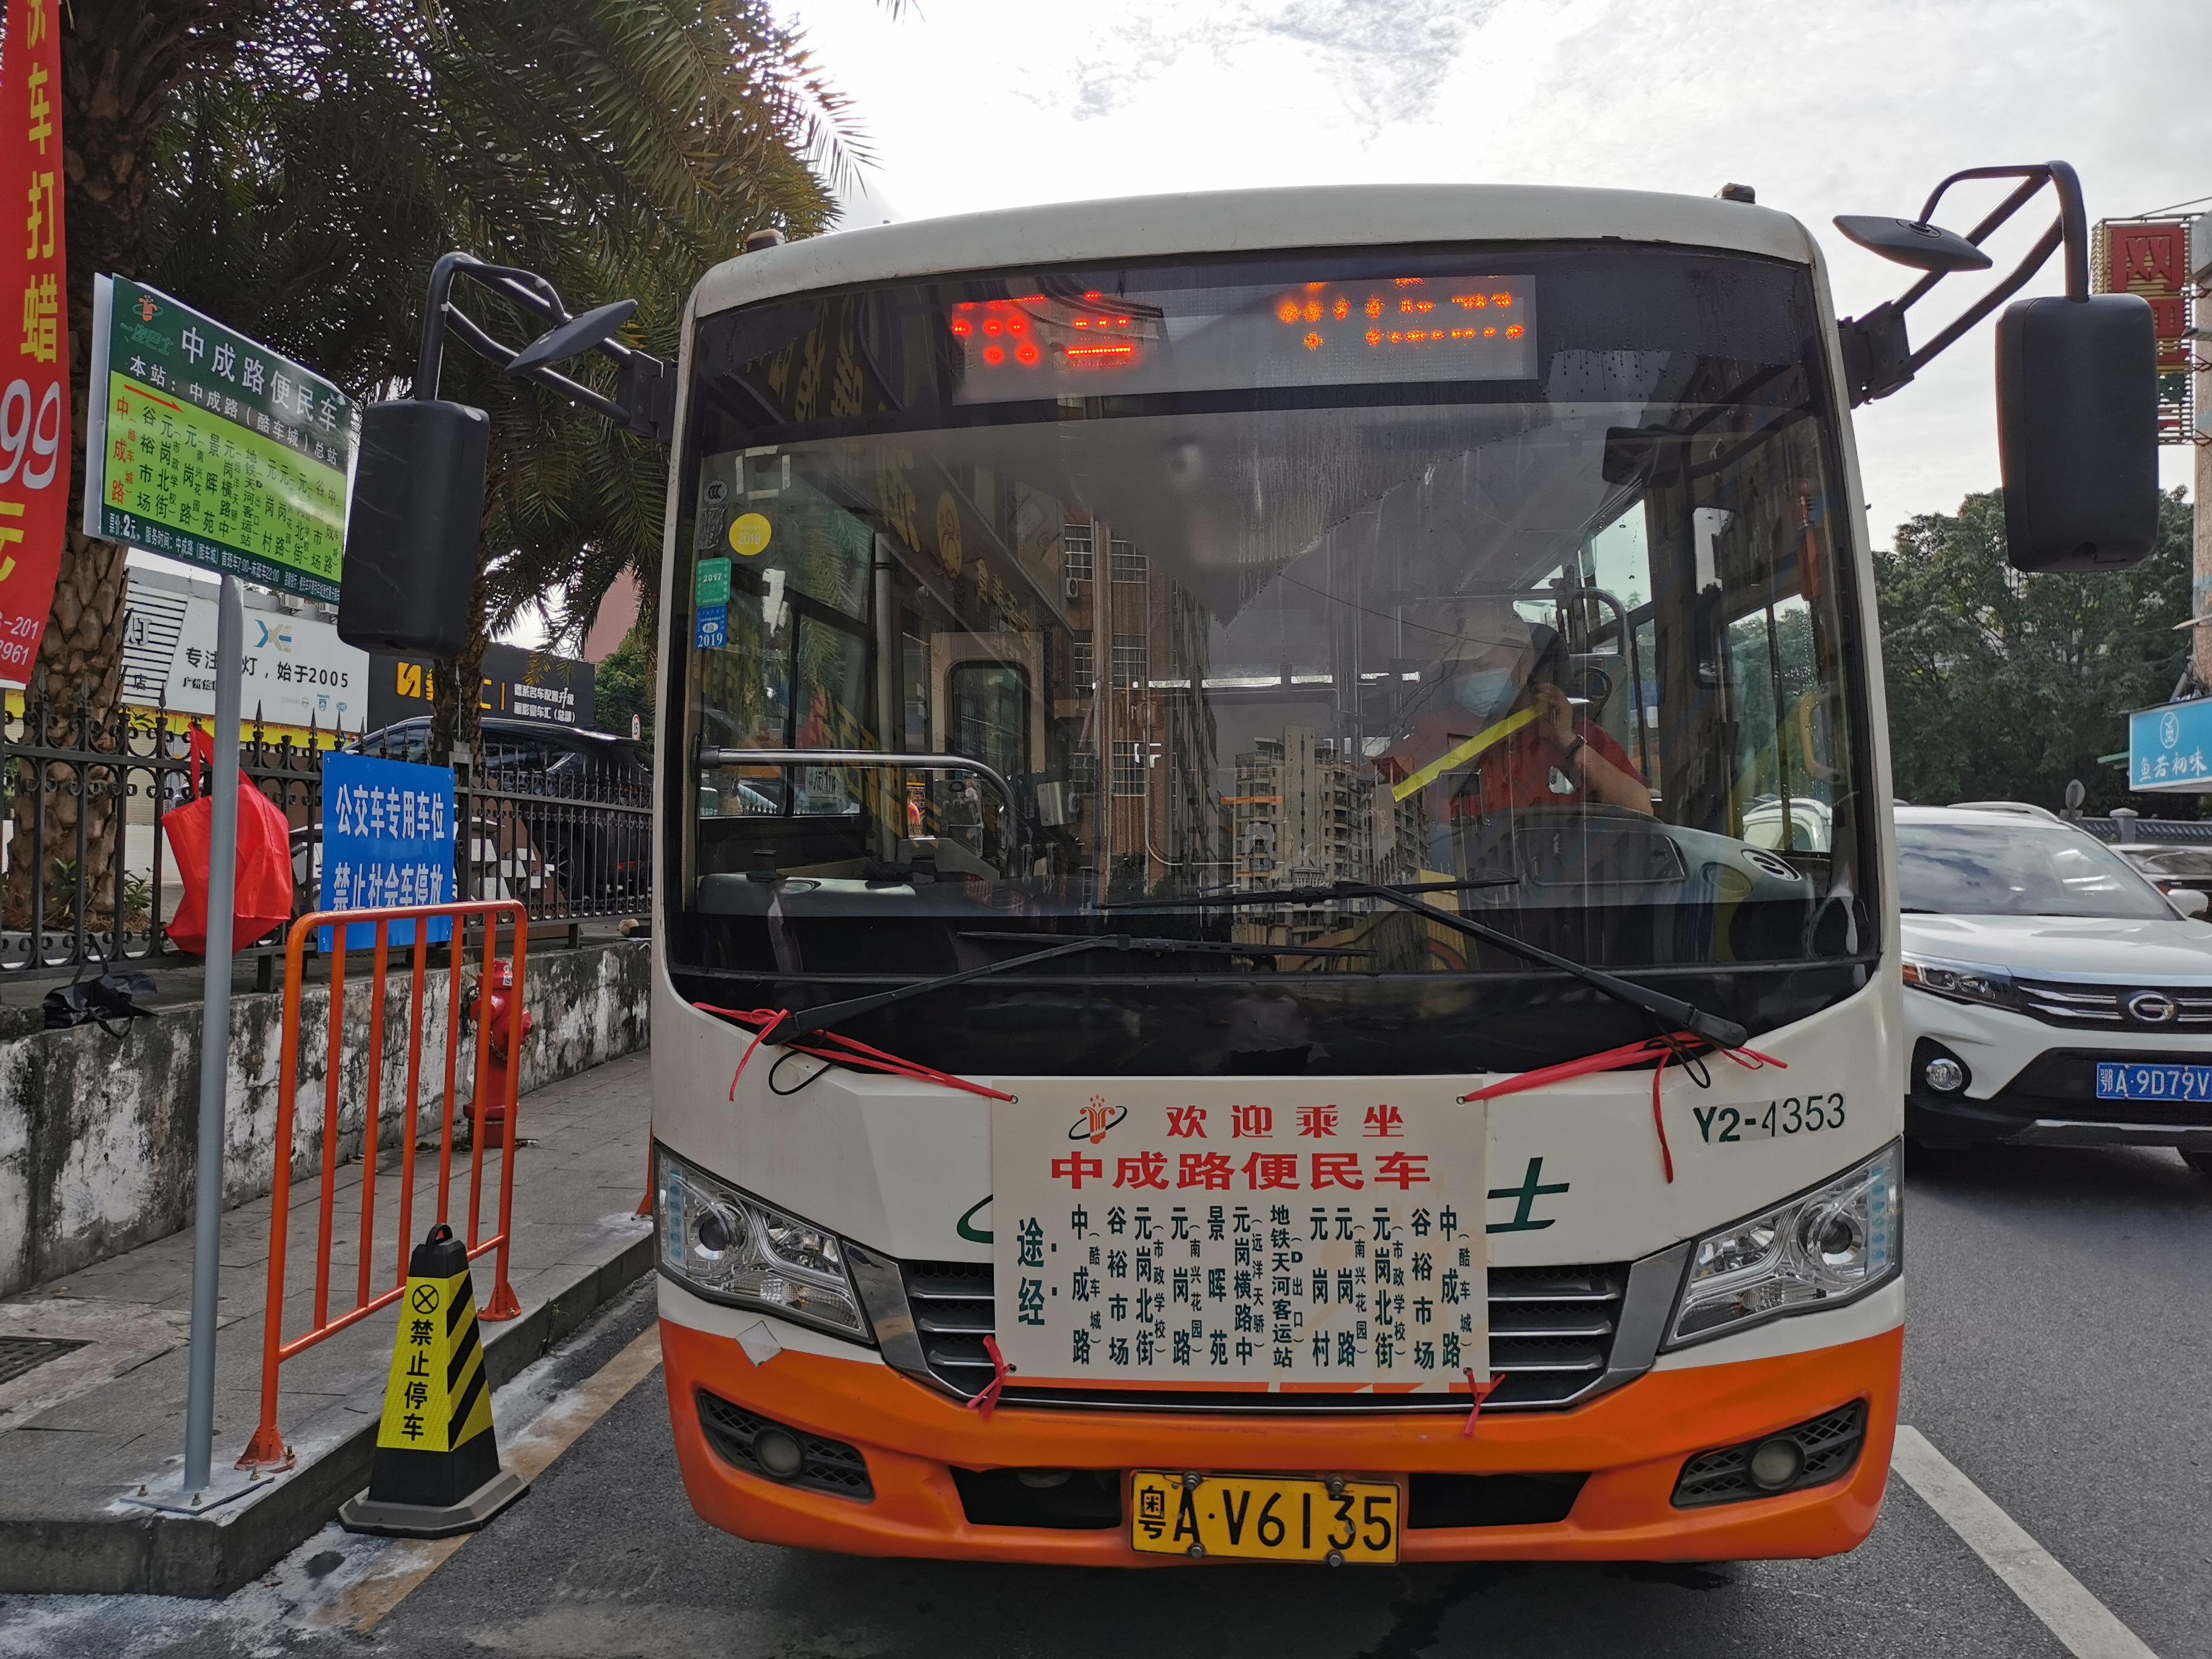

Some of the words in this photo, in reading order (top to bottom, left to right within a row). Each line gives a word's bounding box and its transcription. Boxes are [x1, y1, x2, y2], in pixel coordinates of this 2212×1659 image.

[182, 326, 338, 432] 中成路便民车
[112, 395, 129, 504] 中成路
[136, 406, 157, 512] 谷裕市场
[155, 414, 173, 519] 元岗北街
[179, 424, 197, 526] 元岗路
[218, 439, 235, 538] 元岗横路中
[240, 448, 258, 548] 地铁天河客运站
[262, 458, 277, 553] 元岗村
[274, 464, 290, 558] 元岗路
[0, 611, 39, 640] -201
[697, 632, 723, 648] 2019
[335, 783, 445, 842] 公交车专用车位
[333, 861, 444, 911] 禁止社会车停放
[1050, 1150, 1431, 1191] 中成路便民车
[1165, 1104, 1406, 1140] 欢迎乘坐
[1692, 1092, 1846, 1143] Y2-4353
[1071, 1203, 1091, 1366] 中成路
[1088, 1232, 1102, 1344] （酷车城）
[1107, 1205, 1129, 1366] 谷裕市场
[1134, 1206, 1155, 1366] 元岗北街
[1152, 1224, 1167, 1353] （市政学校）
[1170, 1207, 1191, 1366] 元岗路
[1188, 1224, 1203, 1353] （南兴花园）
[1207, 1205, 1228, 1366] 景晖苑
[1232, 1206, 1253, 1366] 元岗横路中
[1250, 1218, 1265, 1349] （远洋天骄）
[1270, 1204, 1293, 1369] 地铁天河客运站
[1290, 1237, 1305, 1344] （D出口）
[1310, 1207, 1330, 1368] 元岗村
[1335, 1207, 1356, 1368] 元岗路
[1353, 1225, 1368, 1355] （南兴花园）
[1372, 1207, 1394, 1369] 元岗北街
[1391, 1225, 1407, 1356] （市政学校）
[1410, 1207, 1435, 1370] 谷裕市场
[1439, 1204, 1461, 1369] 中成路
[1458, 1233, 1473, 1347] （酷车城）
[401, 1318, 434, 1441] 禁止停车
